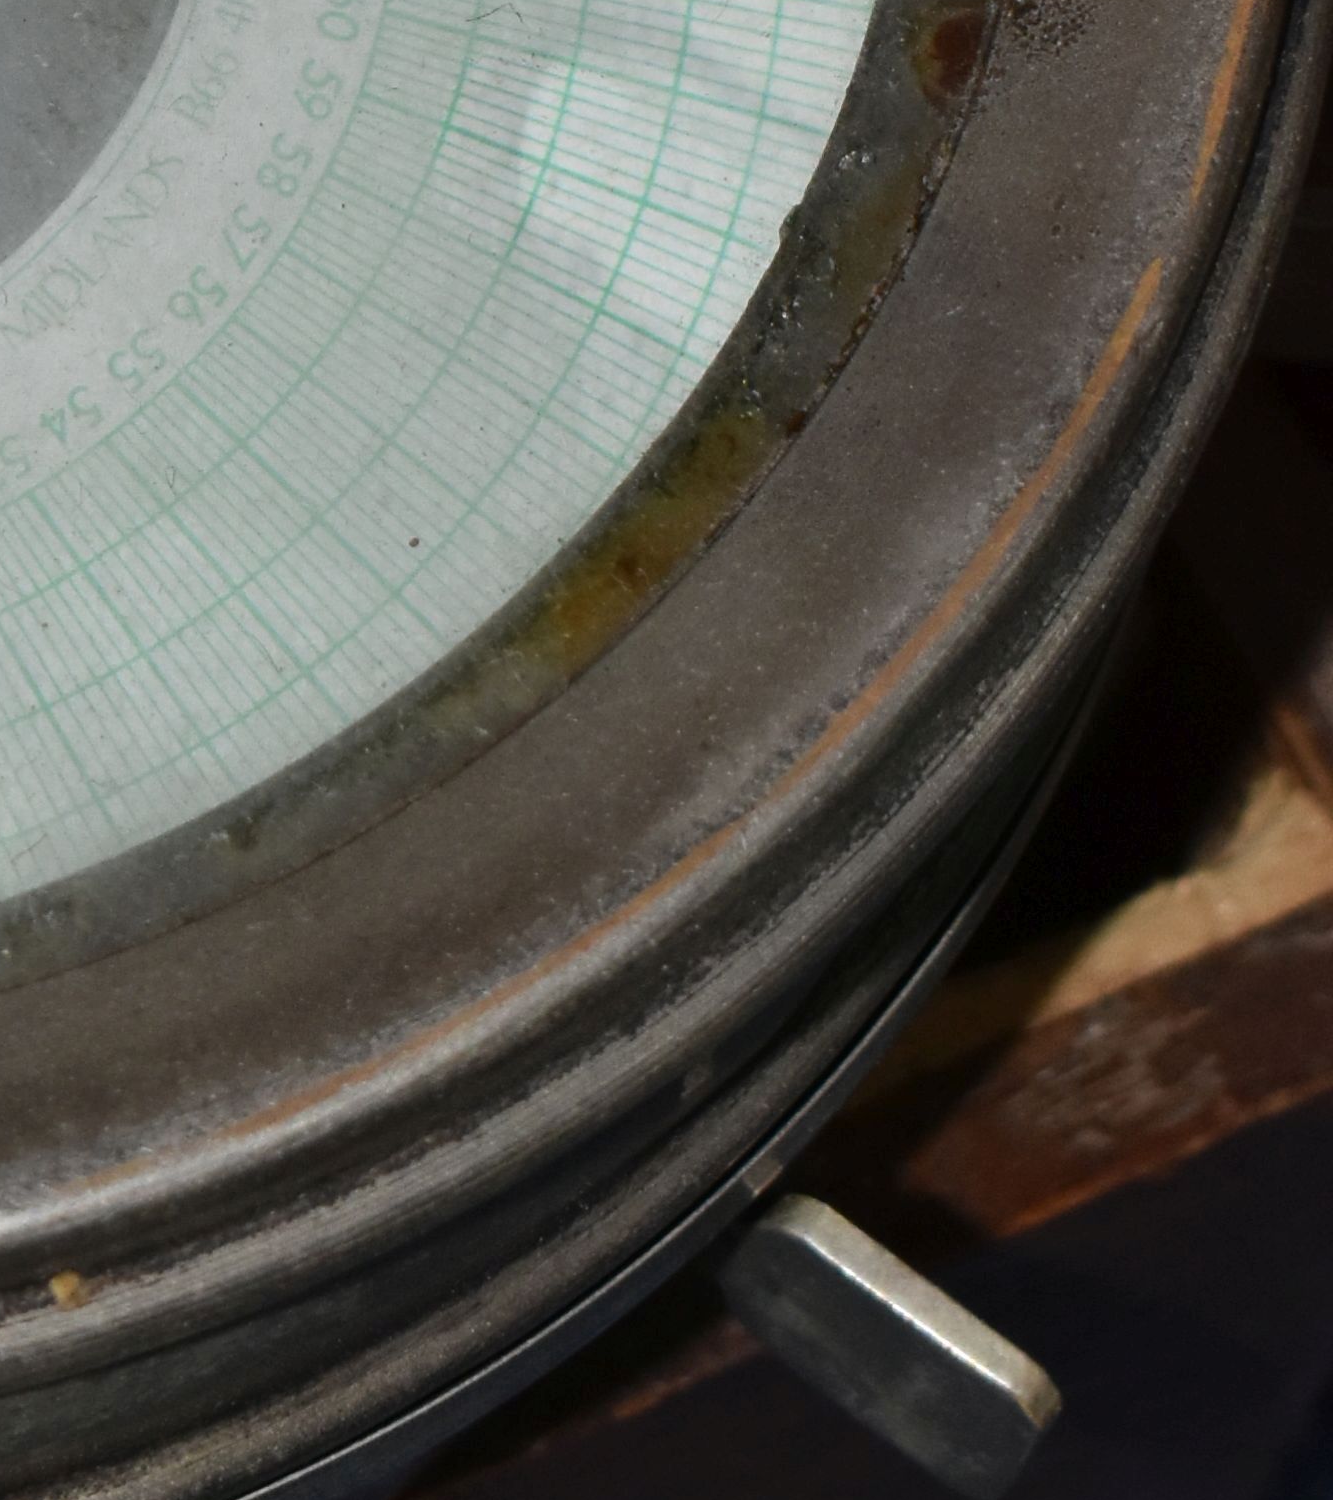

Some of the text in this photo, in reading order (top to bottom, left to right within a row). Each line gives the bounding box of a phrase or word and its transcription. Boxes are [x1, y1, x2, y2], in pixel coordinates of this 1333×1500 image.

[169, 50, 239, 132] B66
[38, 383, 106, 448] 54
[106, 324, 168, 393] 55
[165, 262, 230, 330] 56
[220, 201, 274, 274] 57
[255, 130, 314, 199] 58
[292, 55, 345, 122] 59
